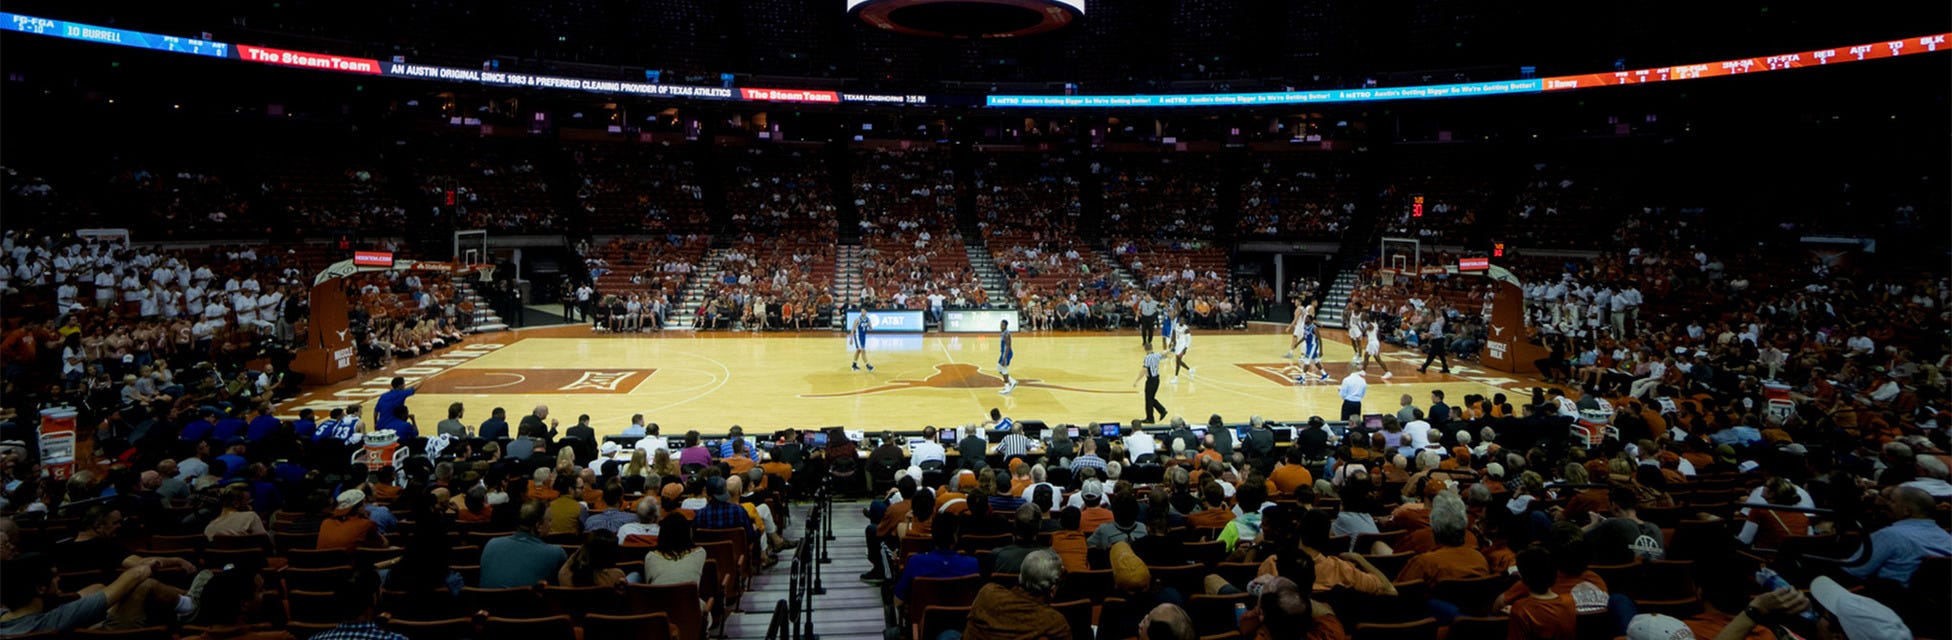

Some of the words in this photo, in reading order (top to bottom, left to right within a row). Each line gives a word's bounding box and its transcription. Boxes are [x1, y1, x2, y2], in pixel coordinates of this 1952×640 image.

[68, 26, 80, 36] 10
[82, 28, 121, 43] BURRELL
[1920, 35, 1946, 45] BLK
[1849, 45, 1873, 54] AST
[1888, 41, 1903, 50] TO
[248, 48, 279, 62] The
[282, 52, 330, 68] Steam
[331, 58, 371, 71] Team
[1813, 50, 1836, 59] REB
[391, 64, 405, 74] AN
[406, 66, 438, 77] AUSTIN
[440, 68, 479, 81] ORIGINAL
[481, 72, 505, 83] SINCE
[507, 75, 526, 84] 1983
[528, 76, 534, 85] &
[536, 77, 580, 88] PREFERRED
[582, 81, 619, 91] CLEANING
[620, 84, 657, 94] PROVIDER
[658, 86, 668, 94] OF
[669, 87, 692, 96] TEXAS
[693, 88, 731, 98] ATHLETICS
[747, 89, 768, 99] The
[770, 91, 803, 101] Steam
[803, 92, 831, 101] Team
[1346, 91, 1371, 99] METRO
[1374, 90, 1400, 98] Austin's
[1402, 89, 1426, 97] Getting
[1428, 88, 1449, 96] Bigger
[1462, 85, 1481, 93] We're
[1483, 84, 1509, 93] Getting
[1511, 82, 1536, 90] Better!
[1215, 96, 1236, 104] Getting
[1238, 95, 1256, 103] Bigger
[1412, 204, 1423, 217] 30
[881, 316, 904, 326] AT&T
[338, 357, 351, 369] MILK
[1564, 402, 1576, 413] 10
[315, 424, 327, 436] 5
[335, 426, 350, 439] 23
[369, 451, 378, 460] G
[55, 467, 65, 478] G
